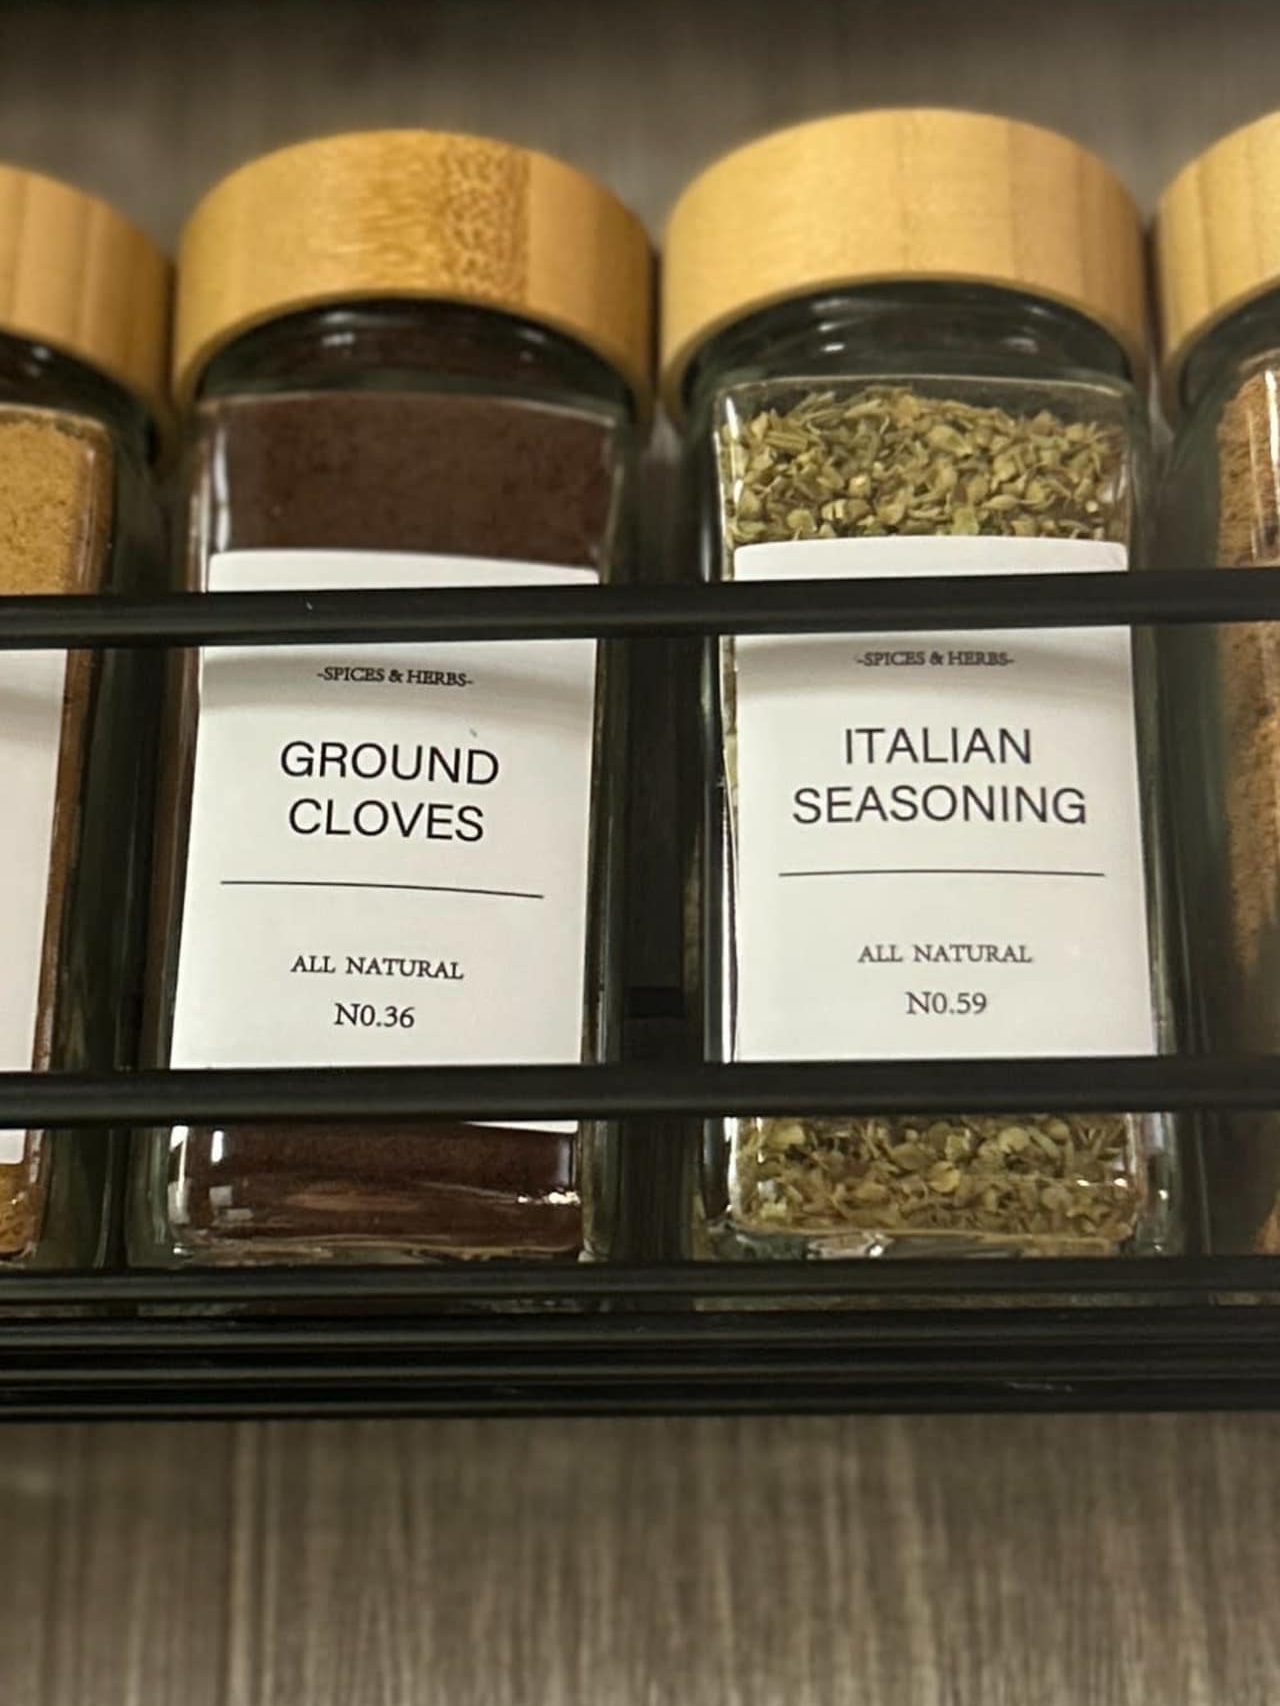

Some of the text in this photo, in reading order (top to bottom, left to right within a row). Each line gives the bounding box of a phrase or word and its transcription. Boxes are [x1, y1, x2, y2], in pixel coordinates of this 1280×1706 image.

[929, 651, 944, 666] &
[388, 669, 403, 683] &
[846, 727, 1031, 764] ITALIAN
[281, 741, 499, 785] GROUND
[289, 798, 483, 842] CLOVES
[793, 785, 1086, 824] SEASONING
[290, 955, 464, 980] ALL NATURAL
[858, 944, 1032, 963] ALL NATURAL
